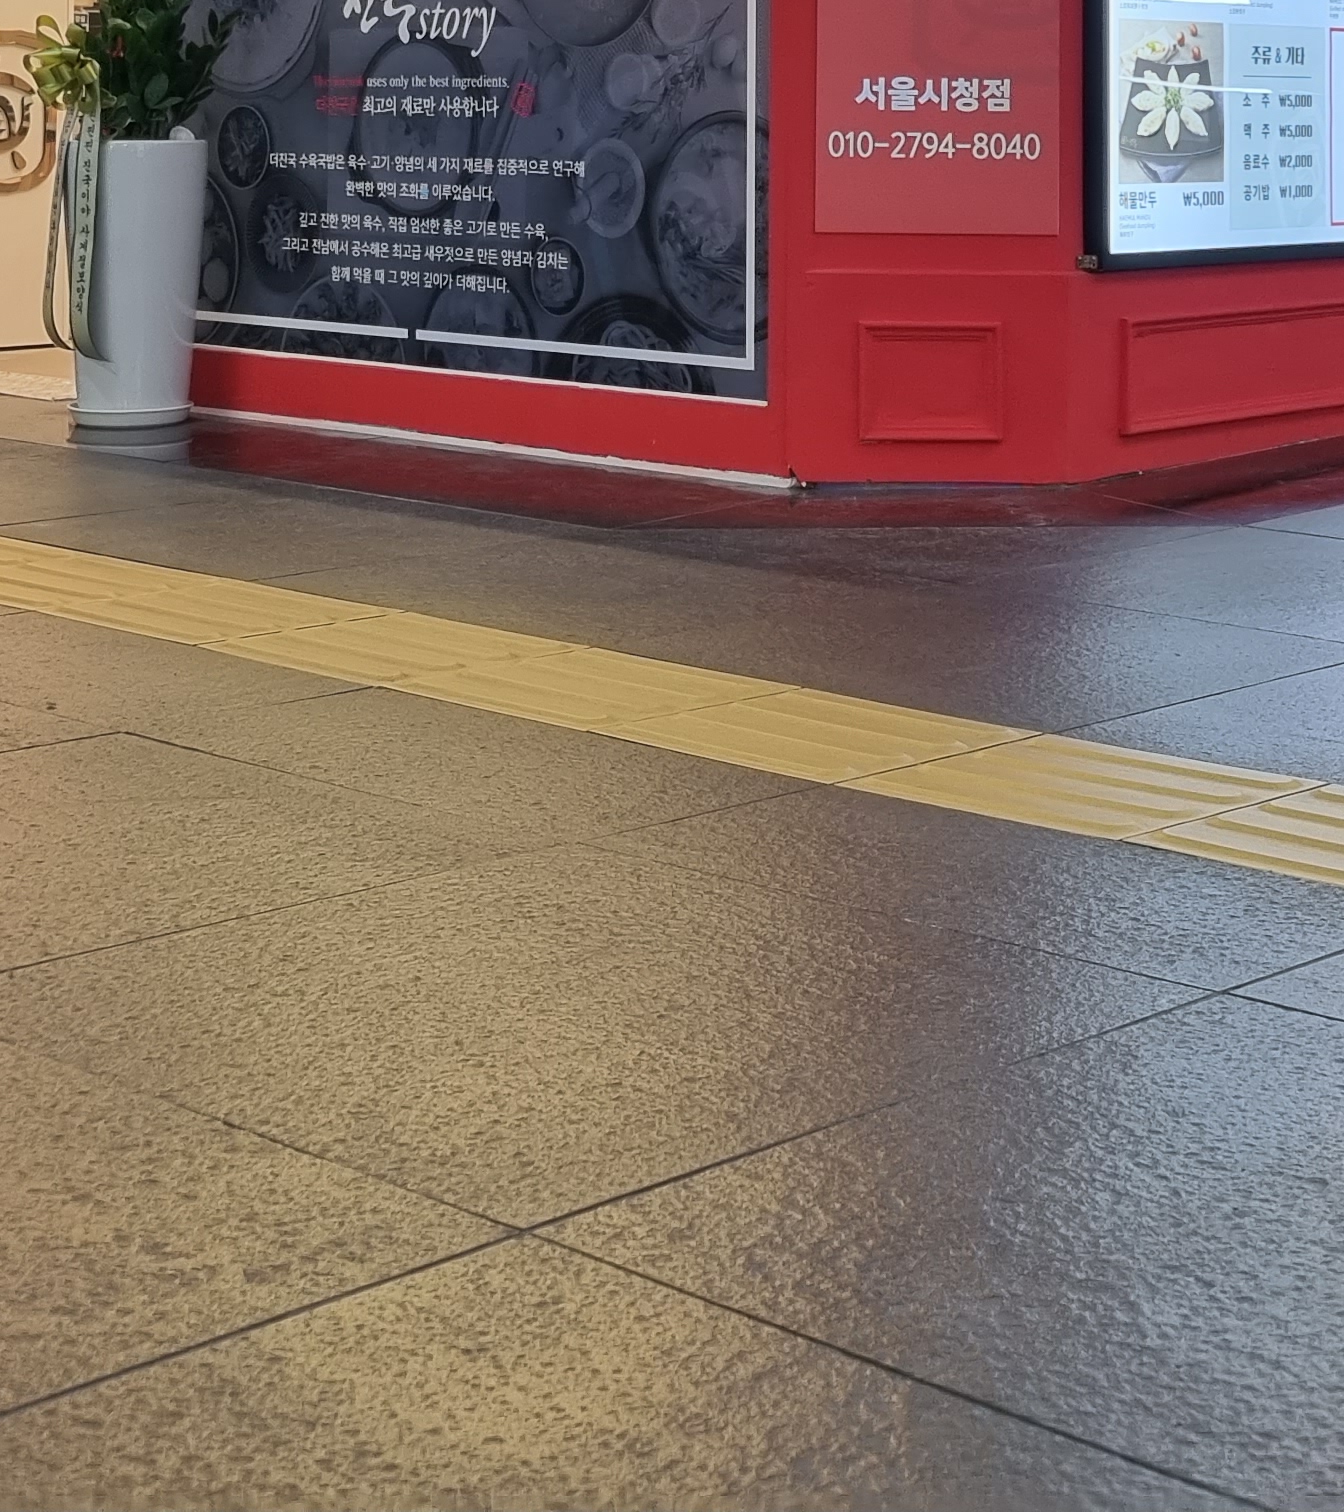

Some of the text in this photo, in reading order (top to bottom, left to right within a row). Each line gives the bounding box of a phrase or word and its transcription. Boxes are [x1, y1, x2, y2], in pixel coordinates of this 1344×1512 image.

[415, 0, 497, 58] story
[1251, 45, 1305, 66] 주류 & 기타
[366, 76, 388, 88] uses
[389, 74, 409, 91] only
[411, 74, 428, 89] the
[429, 74, 449, 89] best
[451, 74, 511, 91] ingredients.
[855, 76, 1012, 112] 서울시청점
[1278, 94, 1313, 110] ₩5,000
[363, 95, 500, 118] 최고의 재료만 사용합니다
[1279, 124, 1313, 140] ₩5,000
[827, 130, 1042, 161] 010-2794-8040
[269, 152, 297, 168] 더진국
[298, 153, 345, 170] 수육국밥은
[426, 156, 438, 173] 세
[439, 157, 460, 174] 가지
[462, 157, 494, 175] 재료를
[496, 158, 550, 176] 집중적으로
[552, 159, 586, 178] 연구해
[1242, 153, 1313, 171] 음료수 ₩2,000
[345, 180, 496, 202] 완벽한 맛의 조화를 이루었습니다.
[1119, 190, 1224, 210] 해물만두 ₩5,000
[1243, 184, 1313, 202] 공기밥 ₩1,000
[298, 212, 549, 242] 깊고 진한 맛의 육수, 직접 엄선한 좋은 고기로 만든 수육,
[282, 237, 569, 270] 그리고 전남에서 공수해온 최고급 새우젓으로 만든 양념과 김치는
[331, 265, 351, 283] 함께
[353, 267, 373, 284] 먹을
[374, 268, 385, 285] 때
[400, 270, 420, 287] 맛의
[422, 271, 454, 289] 깊이가
[456, 273, 511, 294] 더해집니다.
